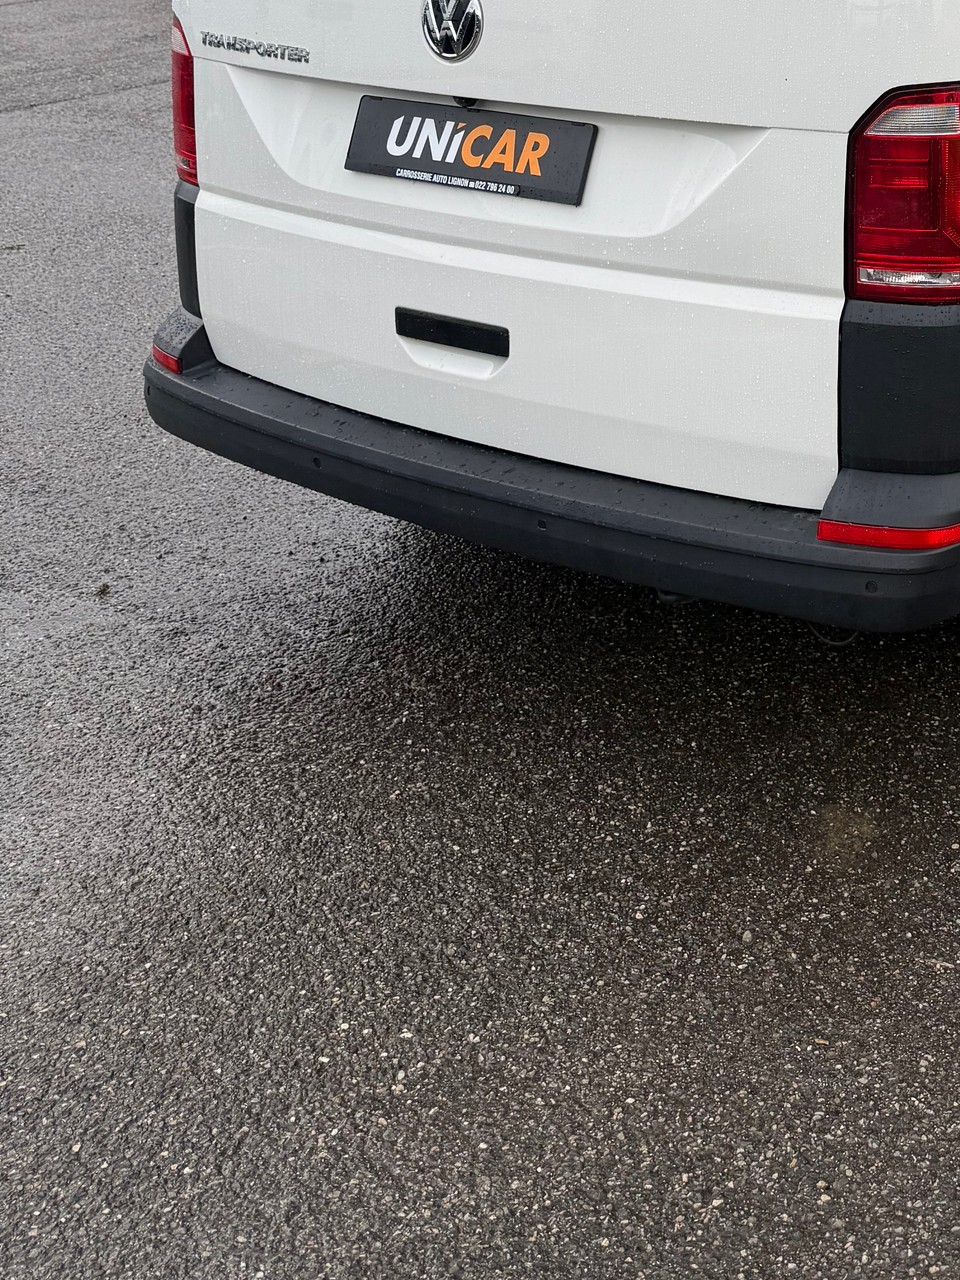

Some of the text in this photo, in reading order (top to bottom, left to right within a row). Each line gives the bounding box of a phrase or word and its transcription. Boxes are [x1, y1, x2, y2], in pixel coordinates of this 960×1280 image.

[200, 31, 310, 64] TRANSPORTER
[396, 168, 515, 194] CARROSSERIE AUTO LIGNON 022 796 24 00
